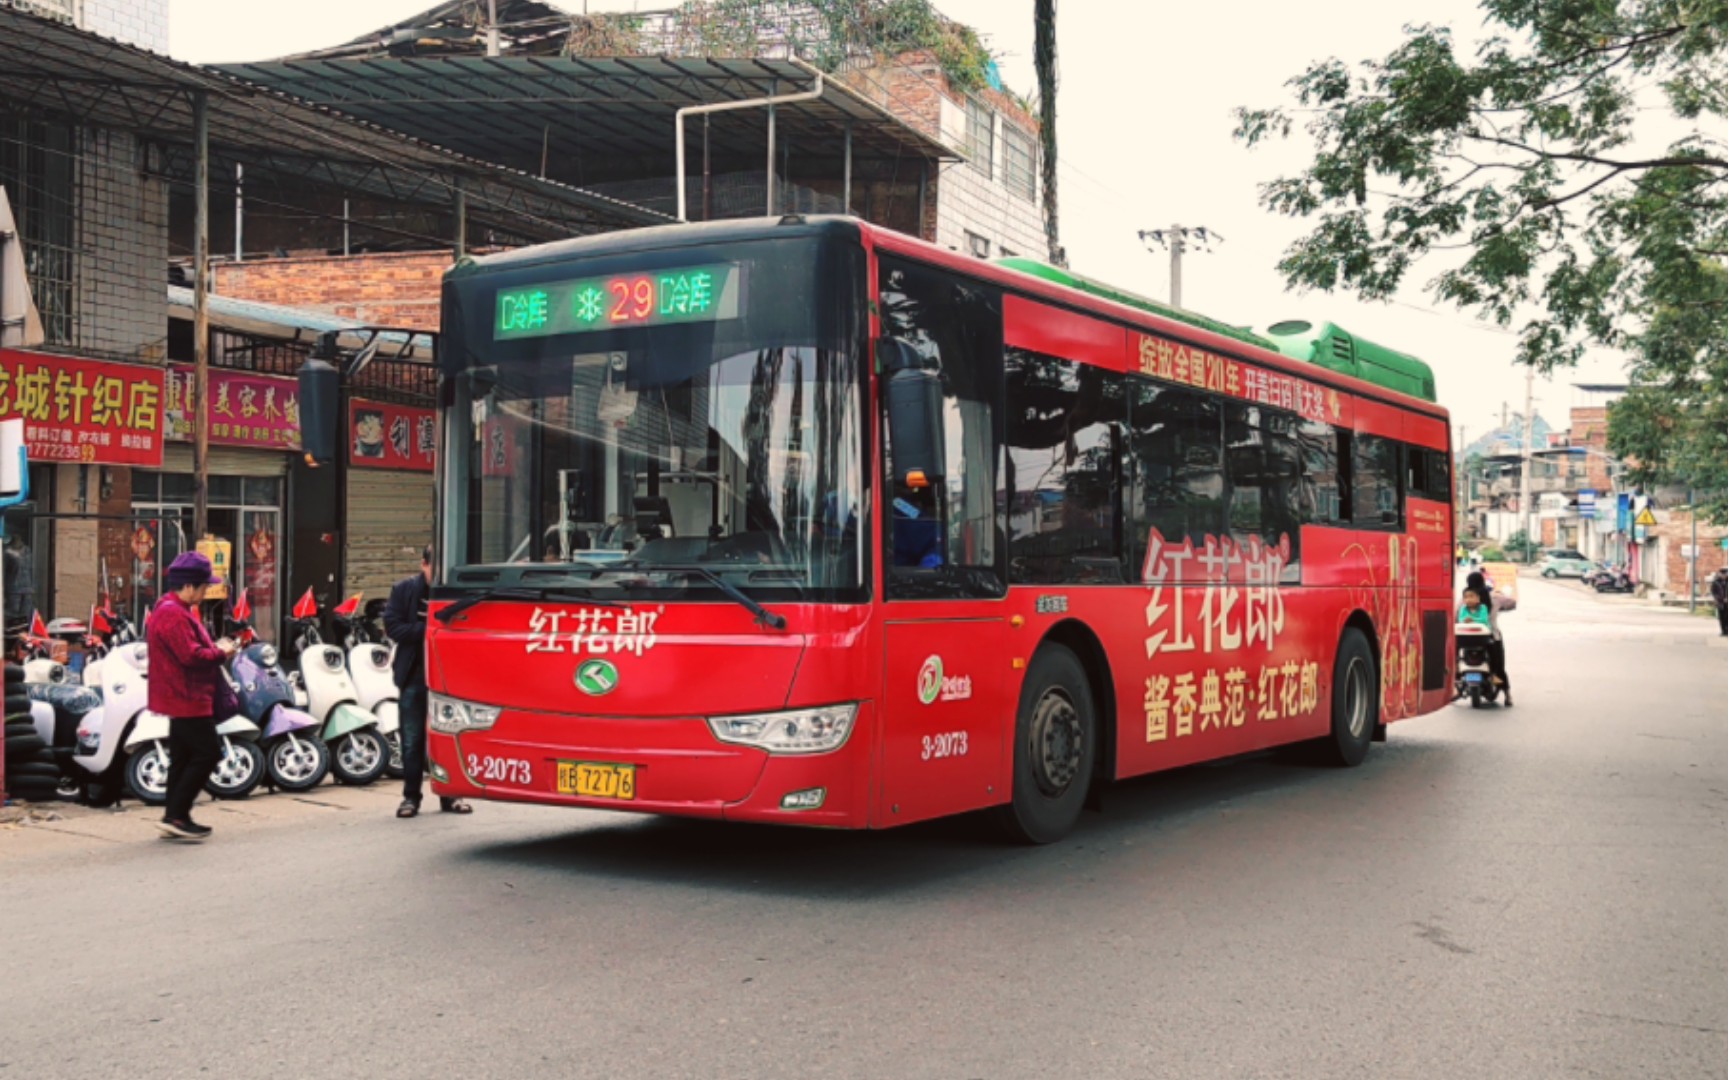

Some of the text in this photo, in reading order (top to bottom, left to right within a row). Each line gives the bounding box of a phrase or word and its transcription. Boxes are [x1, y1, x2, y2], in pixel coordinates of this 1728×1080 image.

[610, 280, 652, 321] 29
[1144, 535, 1285, 661] 红花郎
[525, 606, 659, 657] 红花郎
[922, 730, 968, 760] 3-2073
[468, 754, 532, 784] 3-2073
